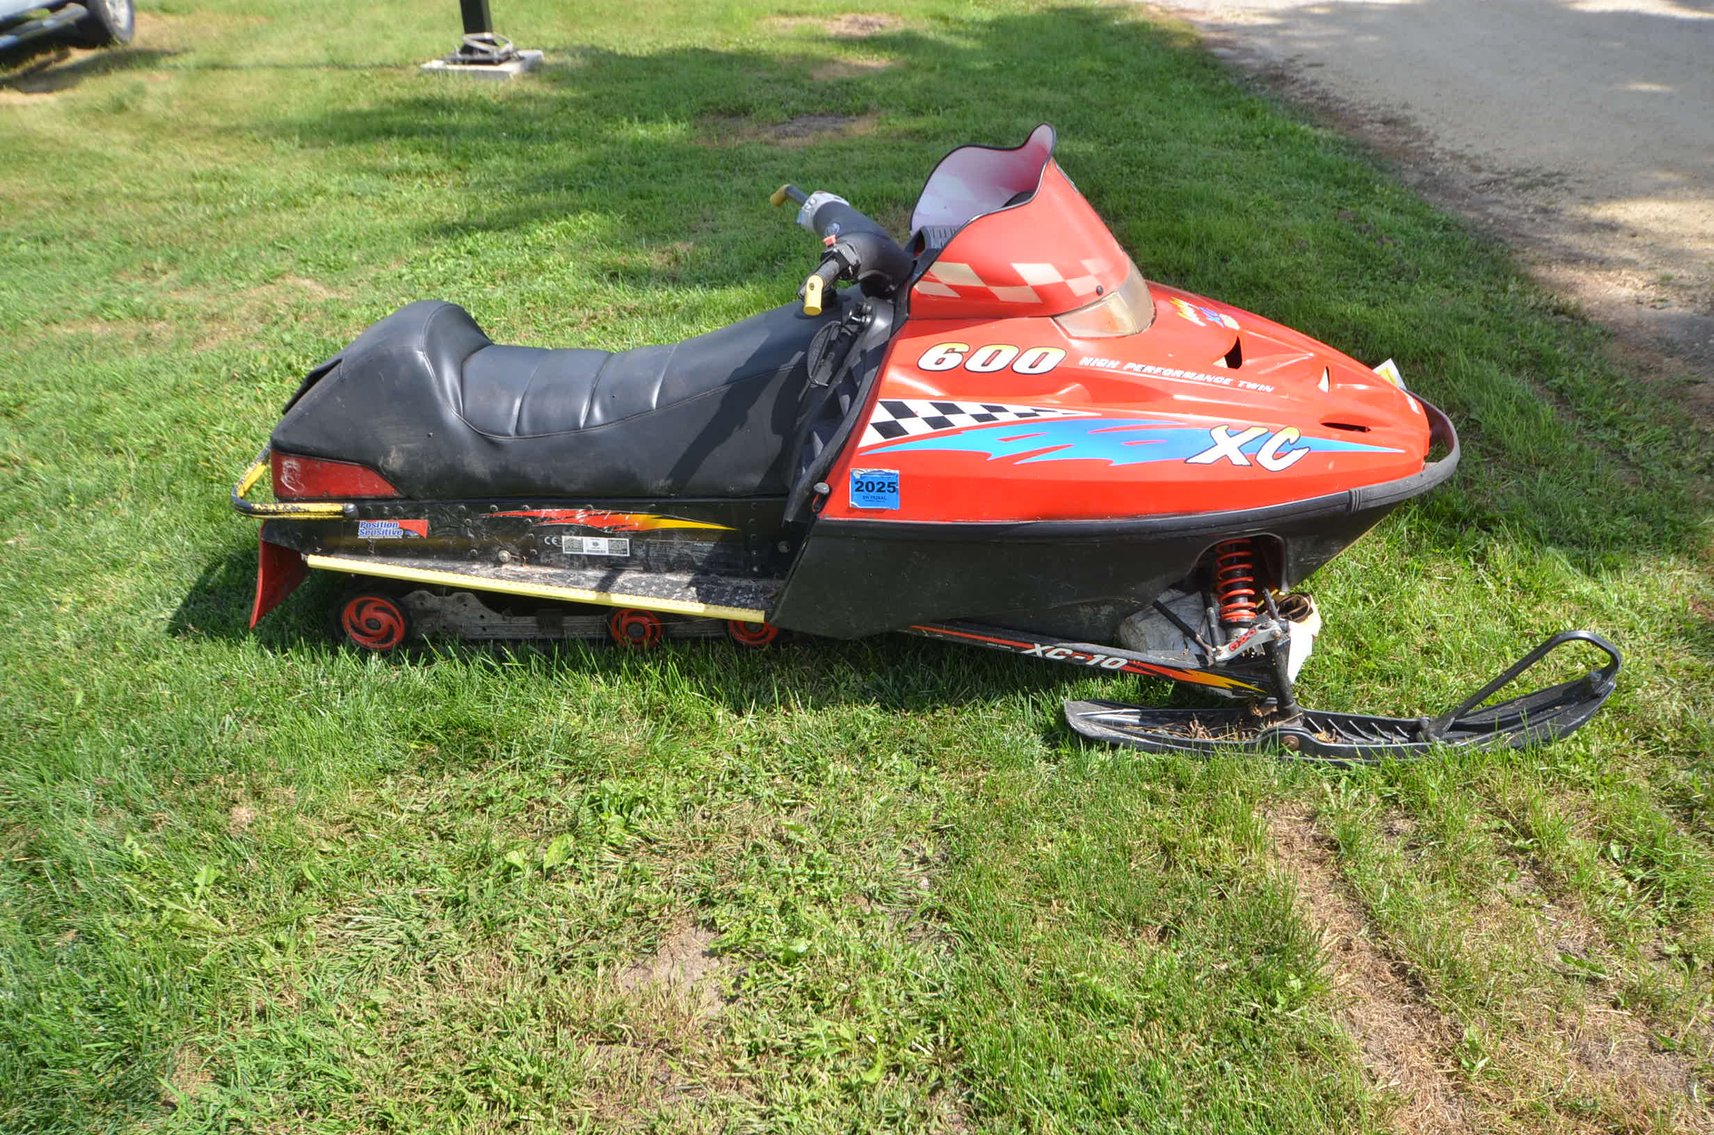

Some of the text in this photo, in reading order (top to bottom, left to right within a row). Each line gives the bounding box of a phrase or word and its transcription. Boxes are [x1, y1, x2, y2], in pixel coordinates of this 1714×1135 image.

[917, 342, 1067, 375] 600
[1079, 356, 1275, 393] HIGH PERFORMANCE TWIN
[1184, 424, 1311, 472] XC
[854, 480, 897, 494] 2025
[359, 520, 399, 529] Position
[359, 528, 403, 537] Sensitive
[1020, 642, 1128, 670] XC-10
